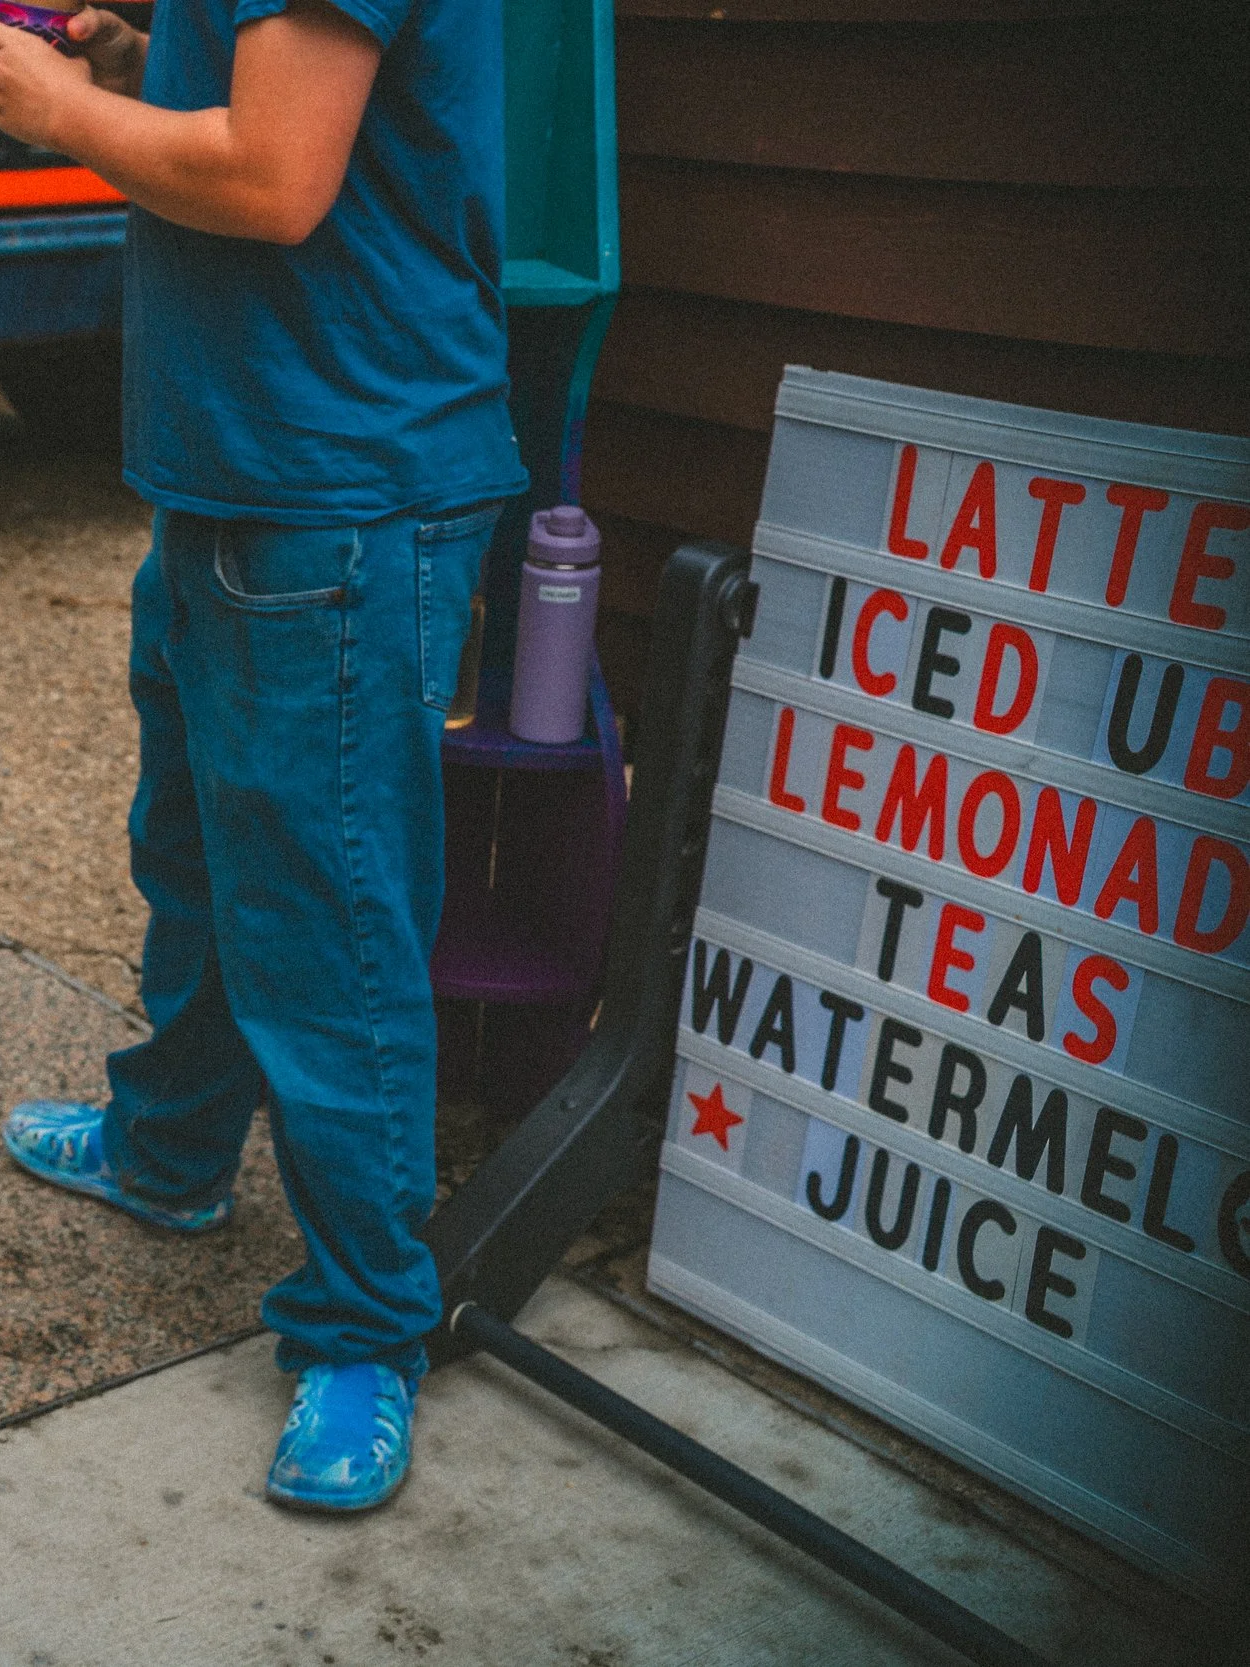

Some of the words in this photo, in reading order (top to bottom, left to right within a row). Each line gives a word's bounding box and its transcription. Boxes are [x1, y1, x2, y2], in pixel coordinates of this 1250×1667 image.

[887, 444, 1250, 631] LATTE
[819, 575, 1040, 736] ICED
[1106, 652, 1250, 799] UB
[768, 706, 1250, 954] LEMONAD
[876, 877, 1130, 1066] TEAS
[805, 1135, 1088, 1340] JUICE
